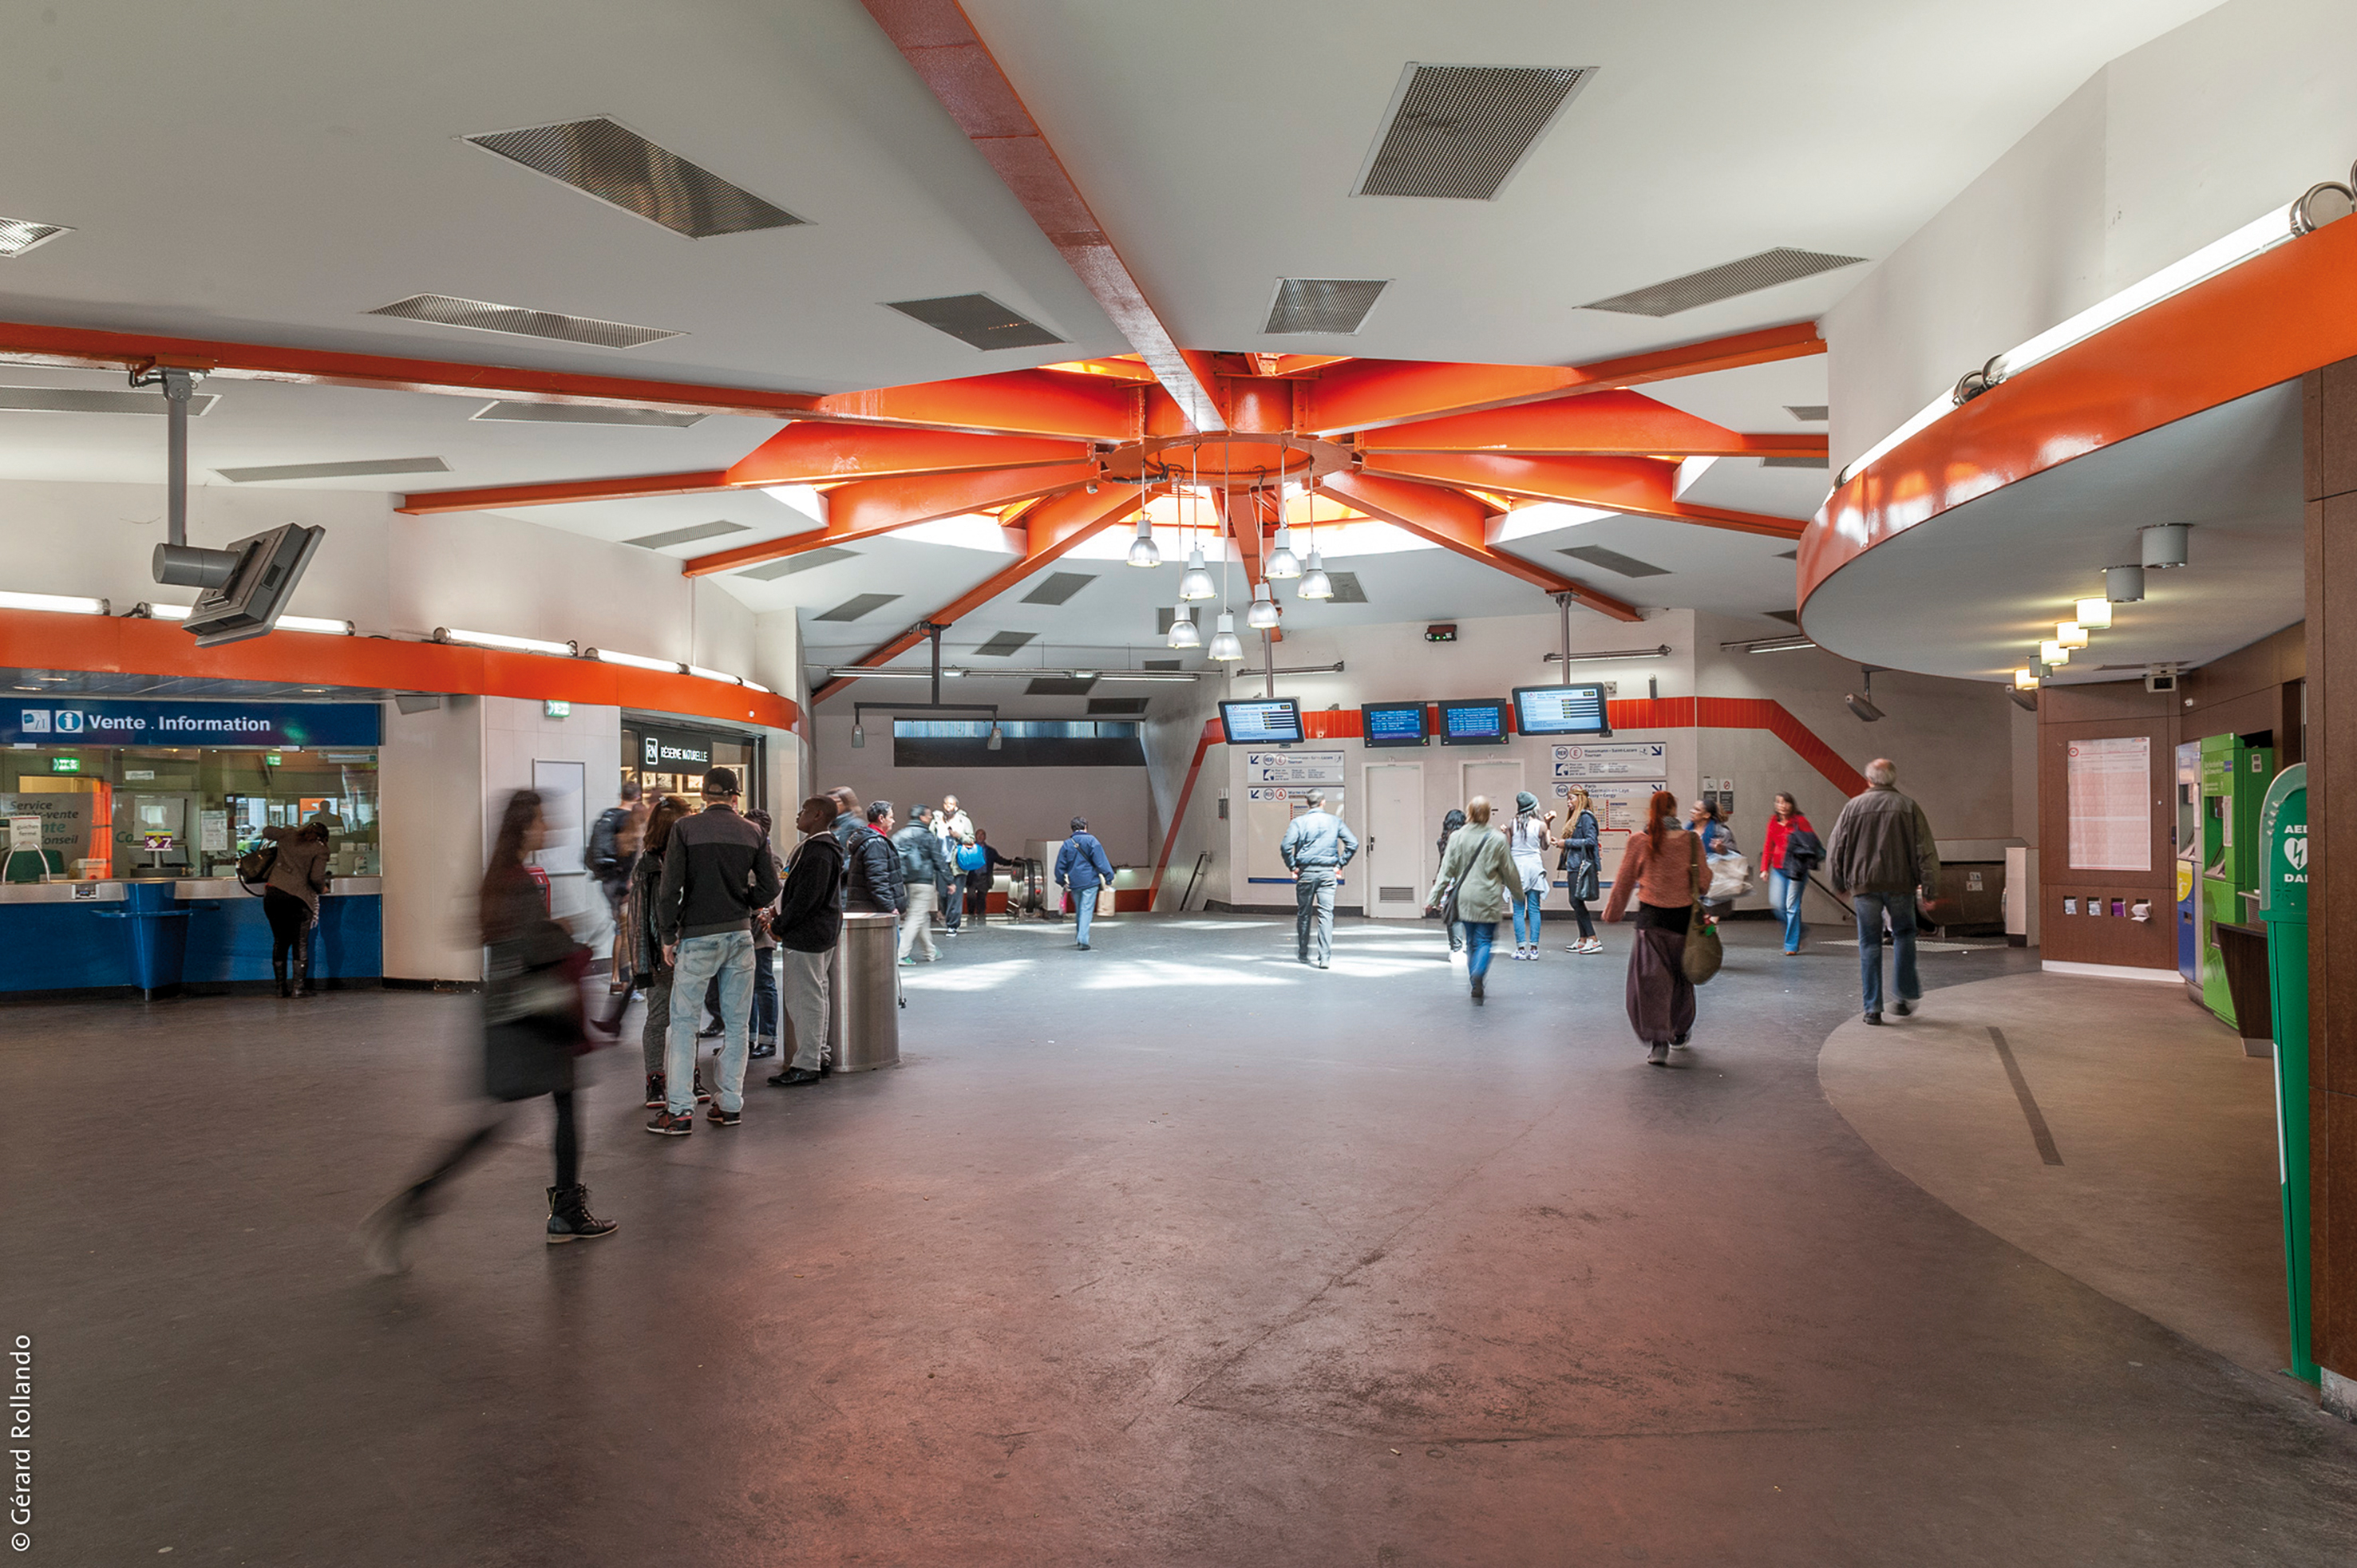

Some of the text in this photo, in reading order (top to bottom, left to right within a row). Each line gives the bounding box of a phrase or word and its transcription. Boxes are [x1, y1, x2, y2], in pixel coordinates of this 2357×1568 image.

[89, 715, 146, 730] Vente
[159, 716, 271, 731] Information
[10, 800, 53, 810] Service
